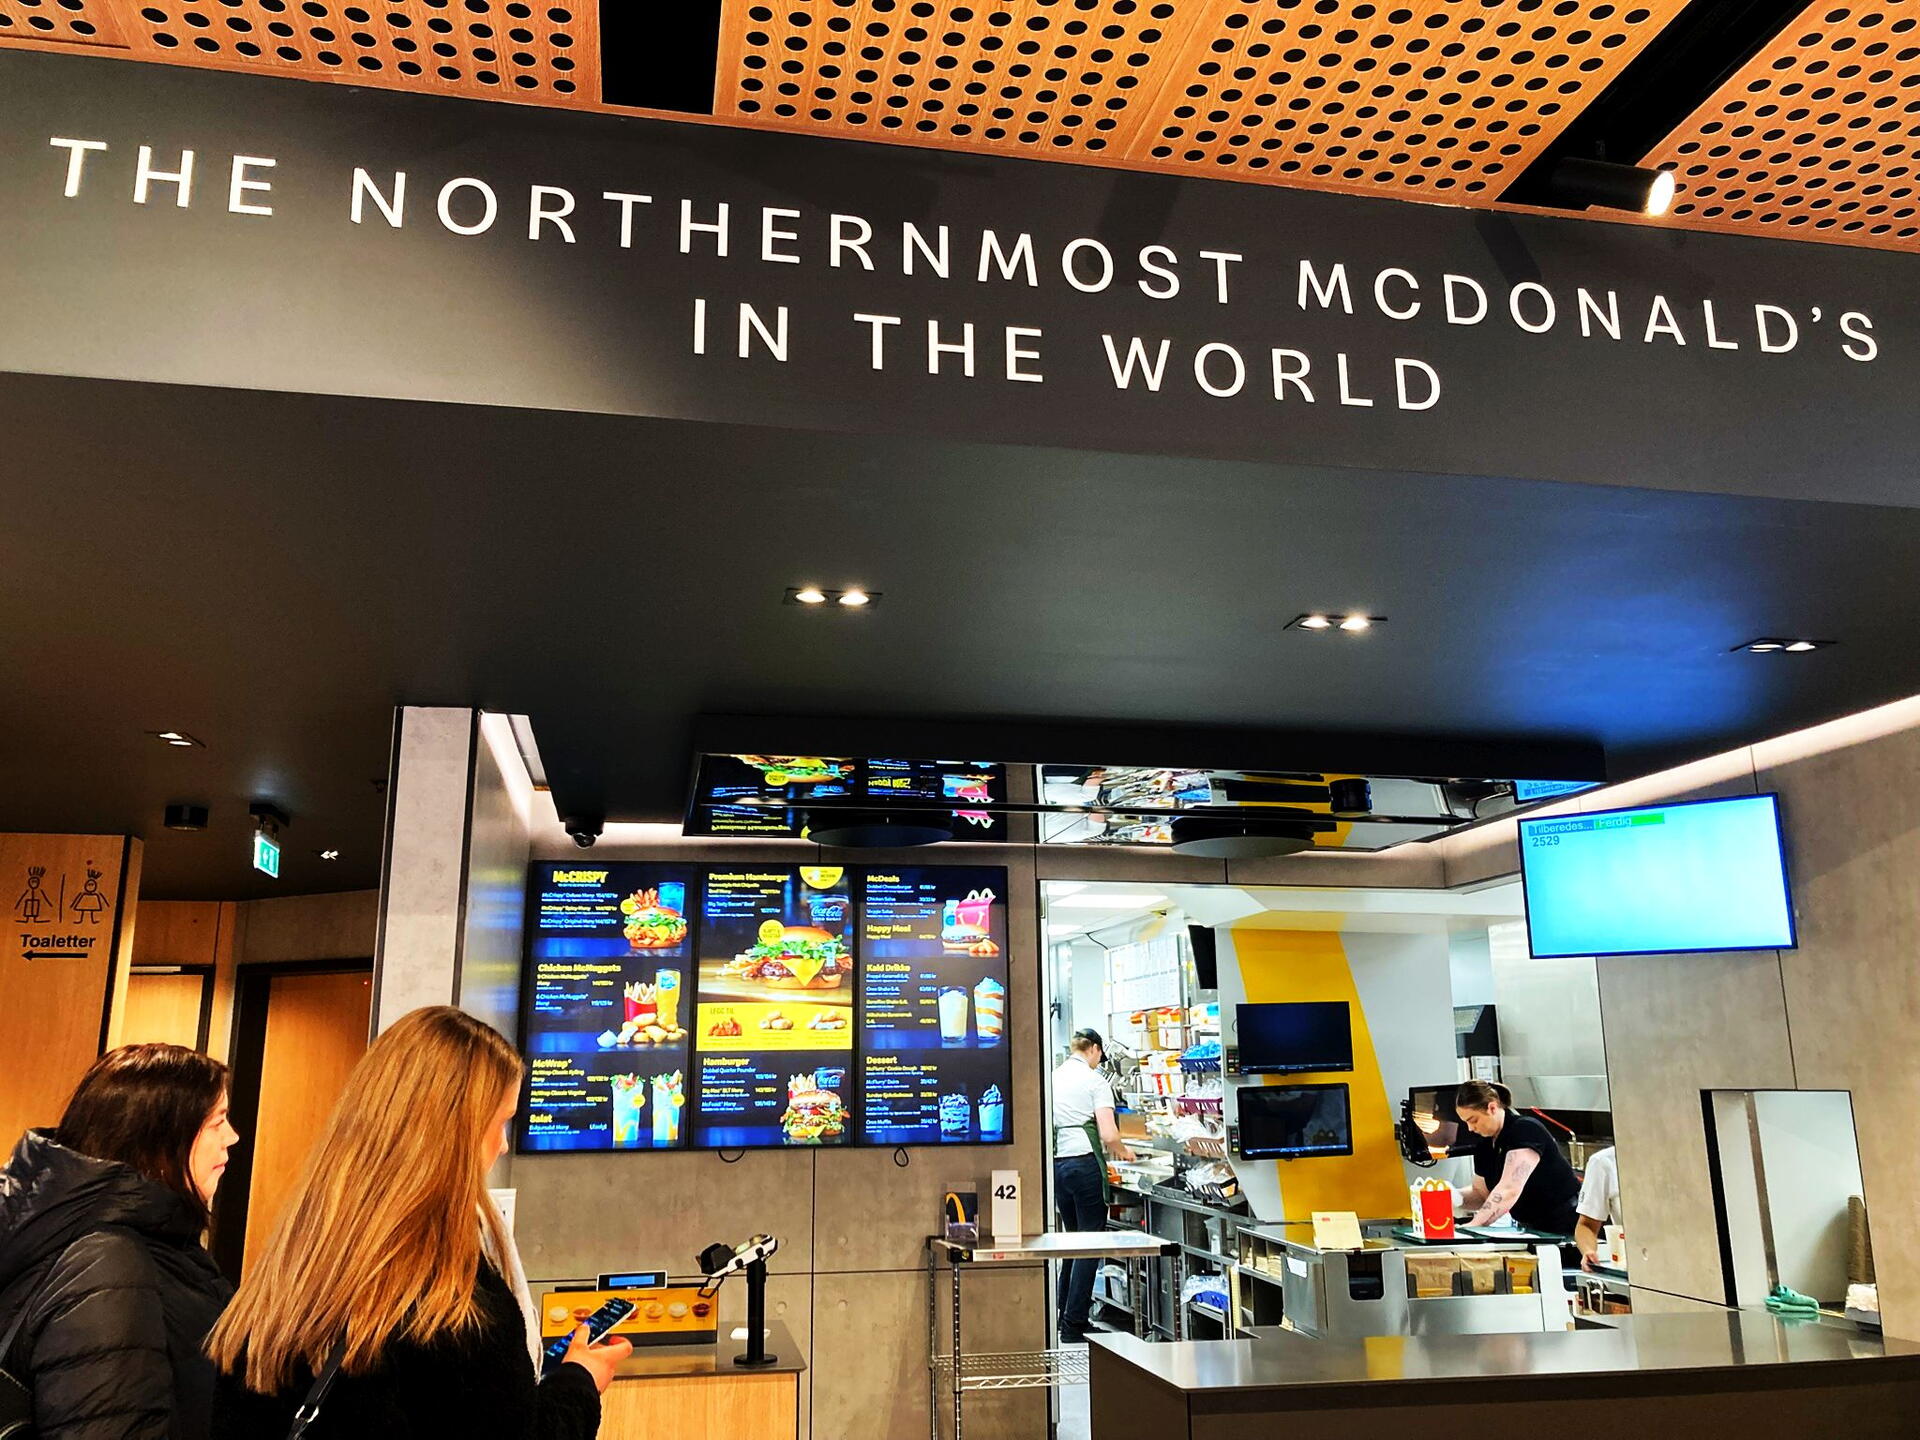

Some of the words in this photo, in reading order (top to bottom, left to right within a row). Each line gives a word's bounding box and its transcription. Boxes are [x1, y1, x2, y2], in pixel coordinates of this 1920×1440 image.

[49, 137, 277, 216] THE
[350, 167, 1243, 304] NORTHERNMOST
[1298, 260, 1878, 362] MCDONALD'S
[694, 298, 788, 362] IN
[853, 313, 1043, 382] THE
[1101, 334, 1441, 410] WORLD
[1532, 835, 1560, 848] 2529
[20, 934, 96, 948] Toaletter
[994, 1184, 1017, 1200] 42
